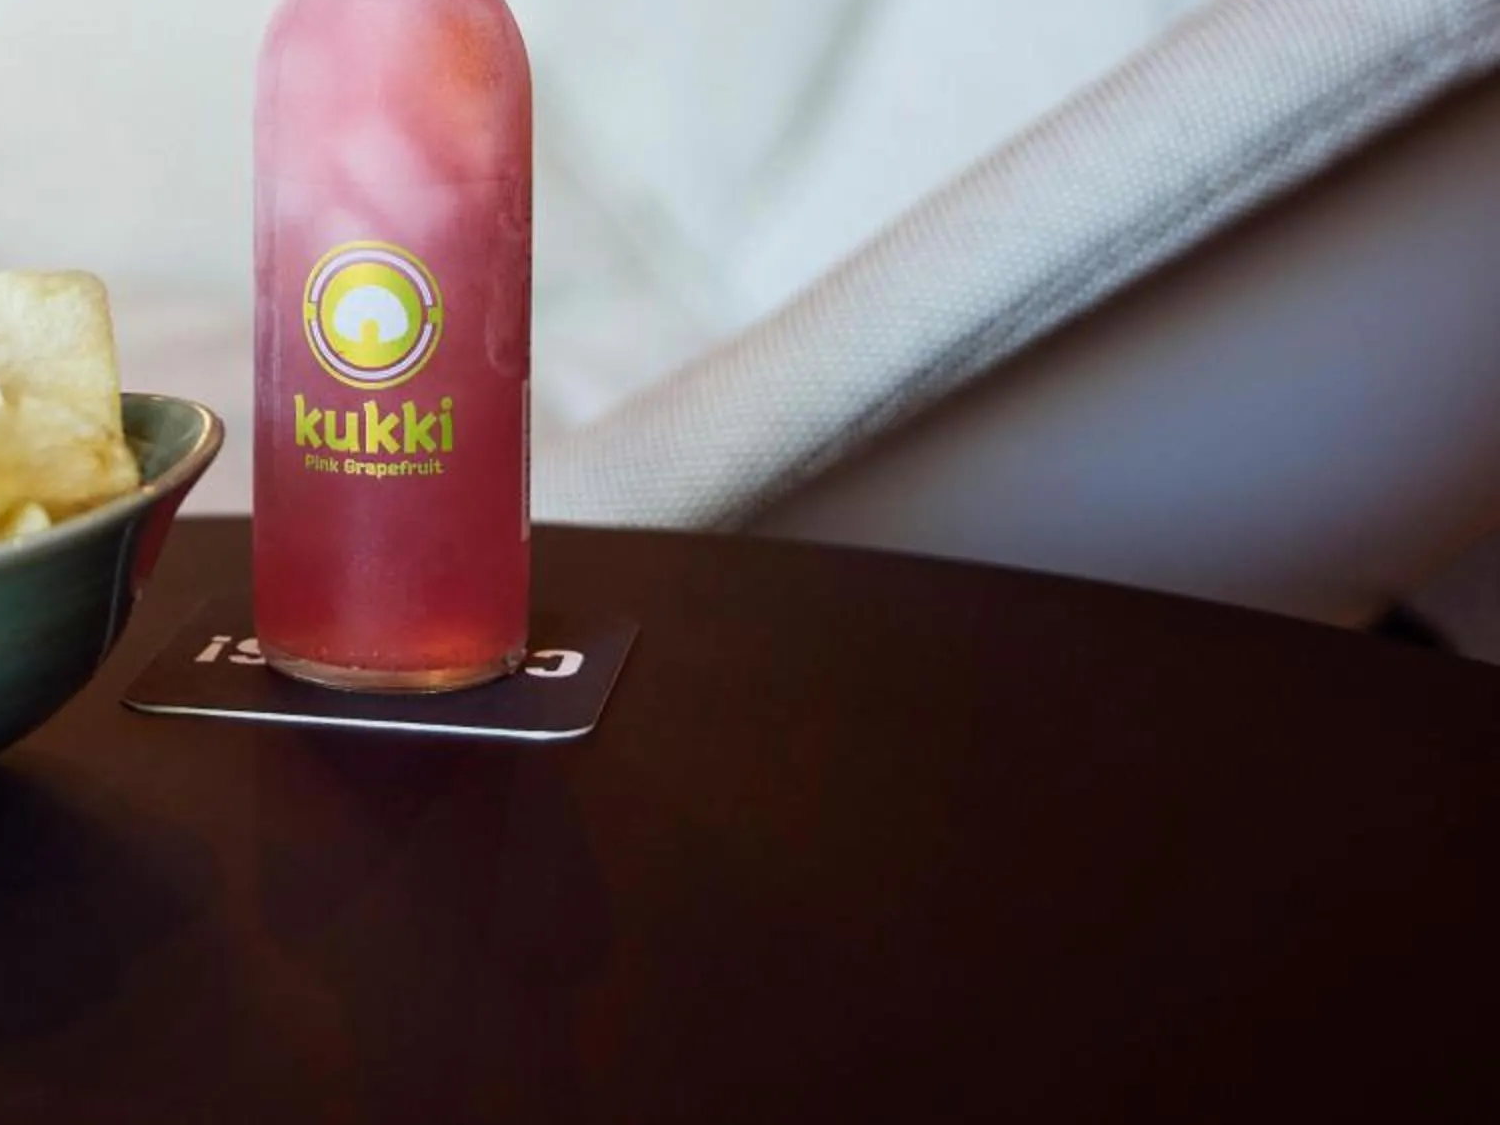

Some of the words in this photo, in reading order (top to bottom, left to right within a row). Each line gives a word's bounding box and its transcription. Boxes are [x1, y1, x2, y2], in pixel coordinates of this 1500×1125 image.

[294, 394, 453, 454] kukki
[305, 454, 339, 473] Pink
[343, 458, 445, 479] Grapefruit
